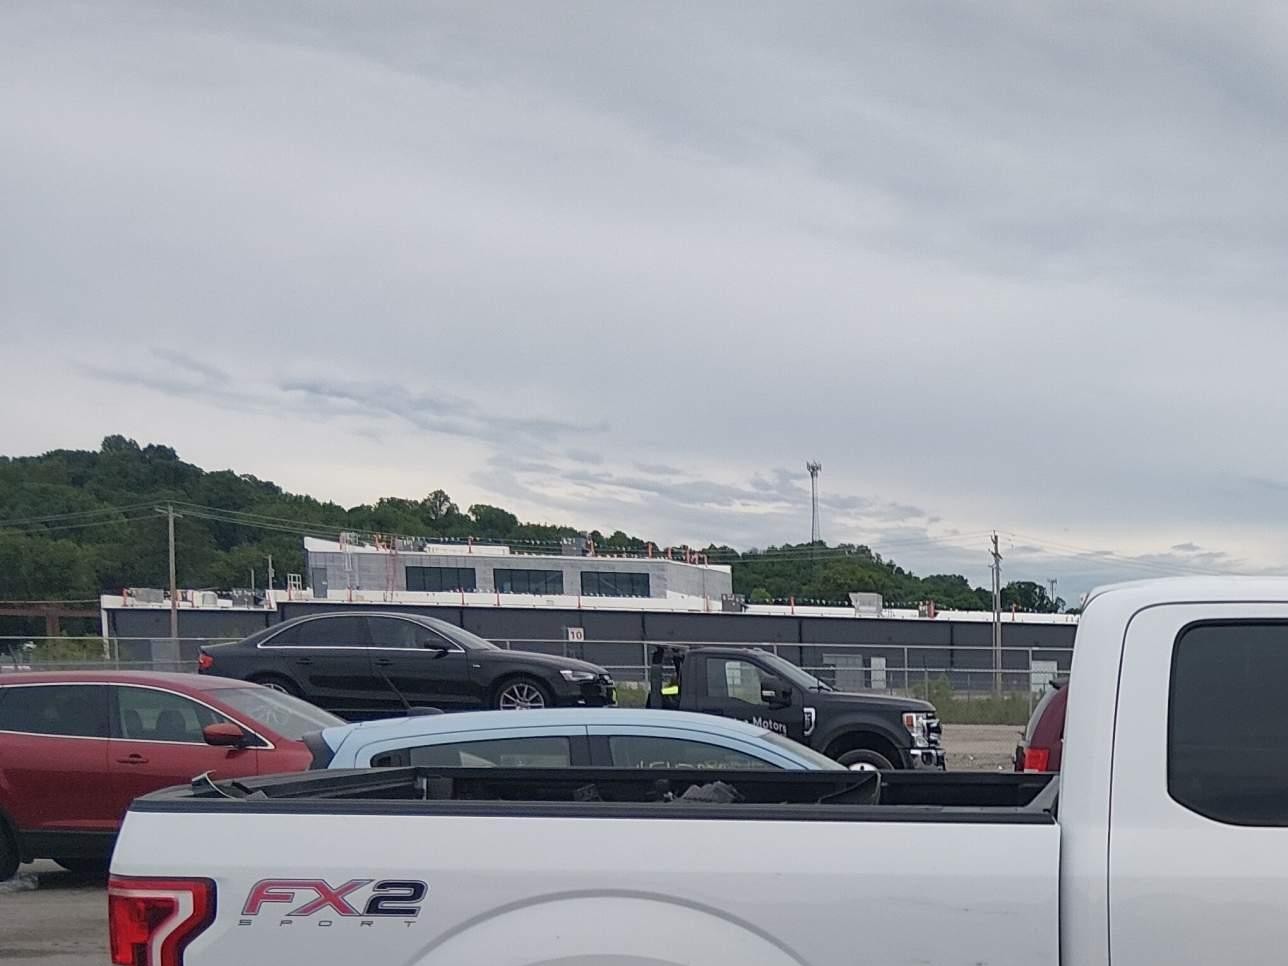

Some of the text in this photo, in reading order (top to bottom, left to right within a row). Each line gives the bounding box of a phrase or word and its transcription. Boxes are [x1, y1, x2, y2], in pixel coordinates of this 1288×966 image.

[570, 631, 583, 640] 10
[752, 716, 788, 736] Motors
[241, 878, 429, 918] FX2
[238, 919, 417, 928] SPORT
